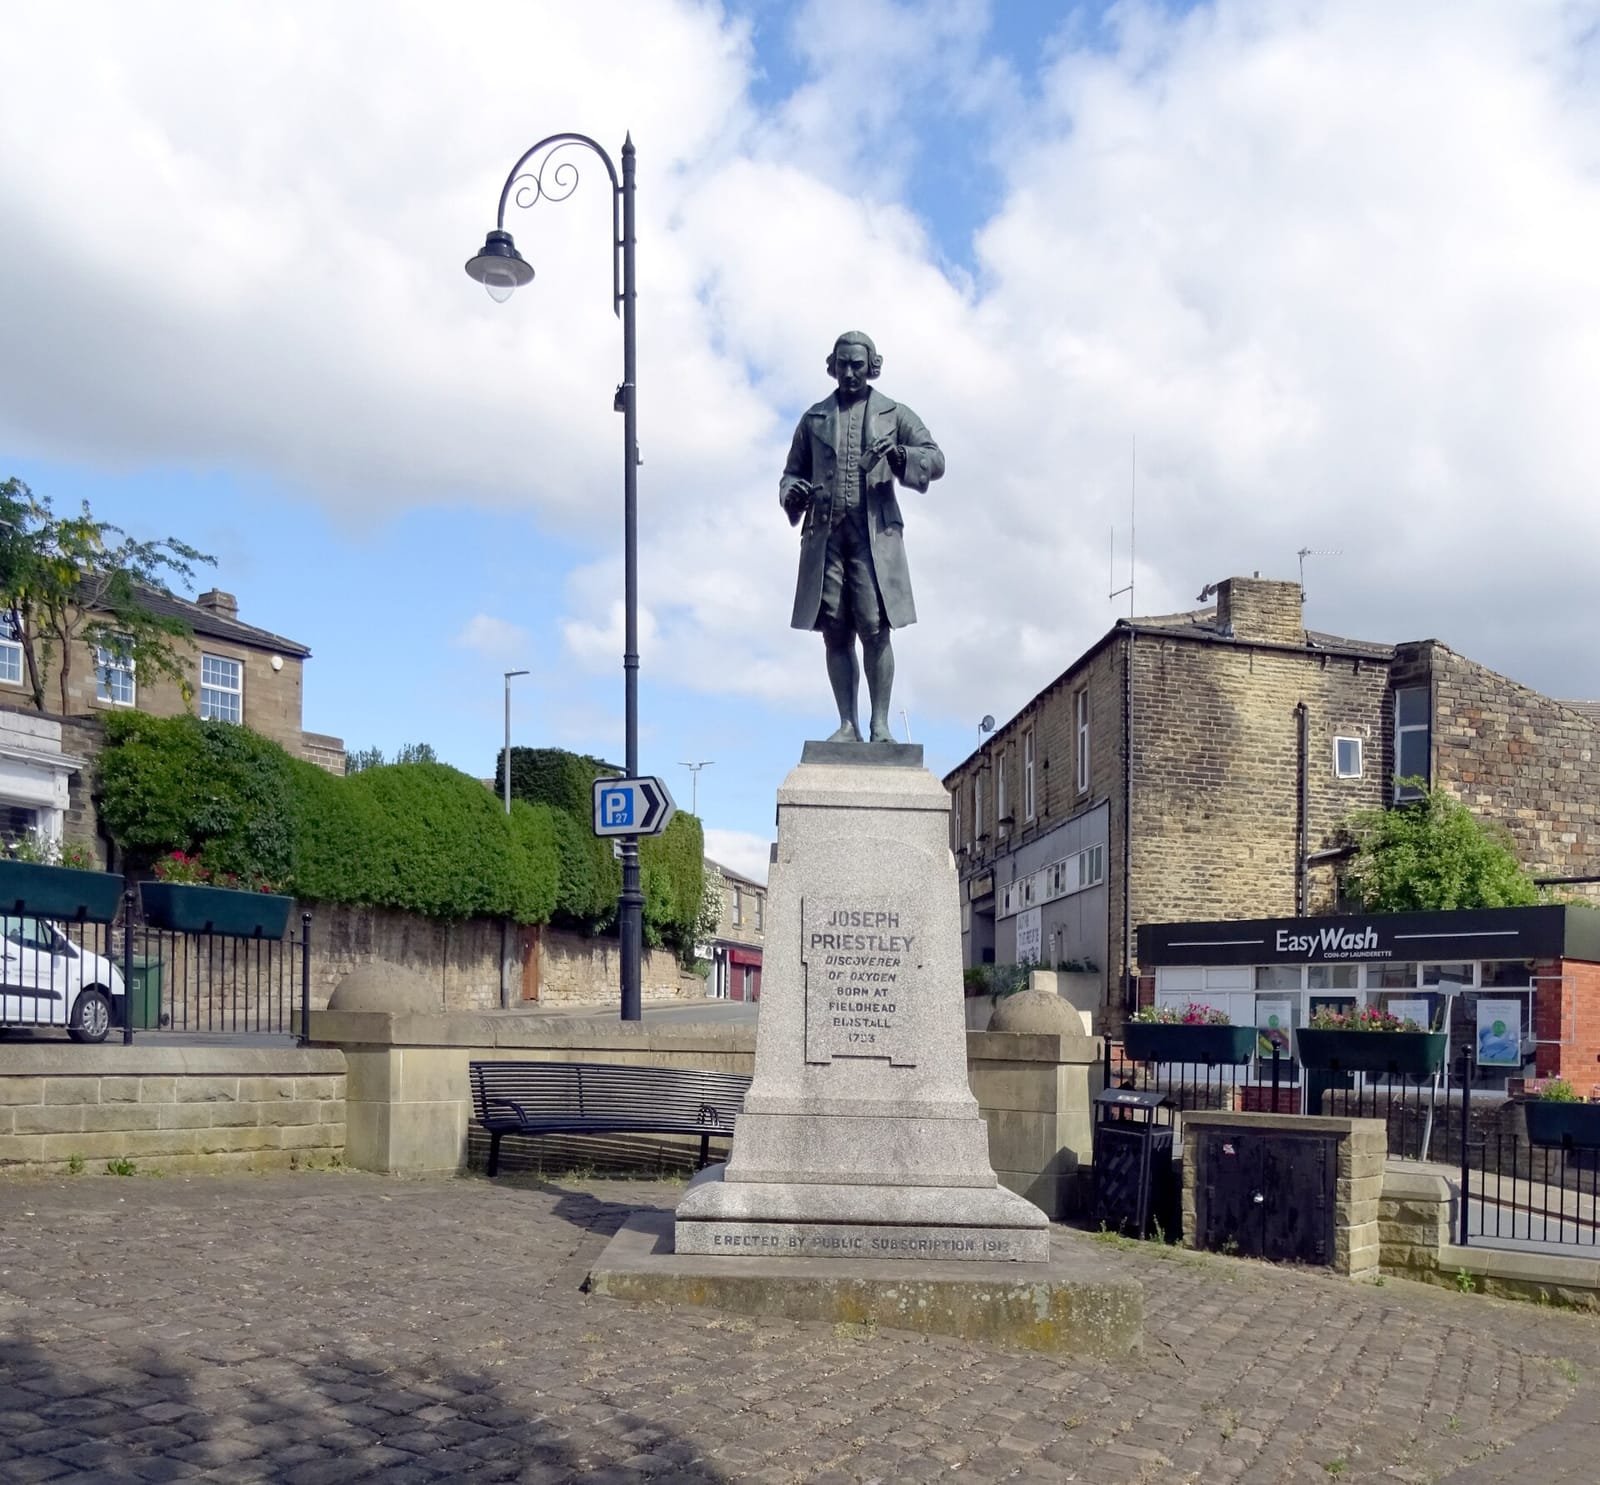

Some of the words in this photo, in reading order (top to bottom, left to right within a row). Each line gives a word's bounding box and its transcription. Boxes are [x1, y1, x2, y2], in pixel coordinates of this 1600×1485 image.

[606, 792, 626, 824] P
[615, 813, 628, 823] 27
[828, 910, 899, 928] JOSEPH
[811, 933, 915, 952] PRIESTLEY
[1276, 926, 1378, 957] EasyWash
[1349, 950, 1392, 958] LAUNDERETTE
[825, 955, 901, 967] DISCOVERER
[828, 971, 844, 980] OF
[850, 972, 896, 982] OXYGEN
[837, 987, 869, 996] BORN
[874, 988, 888, 997] AT
[829, 1002, 896, 1013] FIELDHEAD
[713, 1235, 780, 1247] ERECTED
[788, 1236, 806, 1248] BY
[813, 1238, 862, 1249] PUBLIC
[871, 1239, 974, 1251] SUBSCRIPTION
